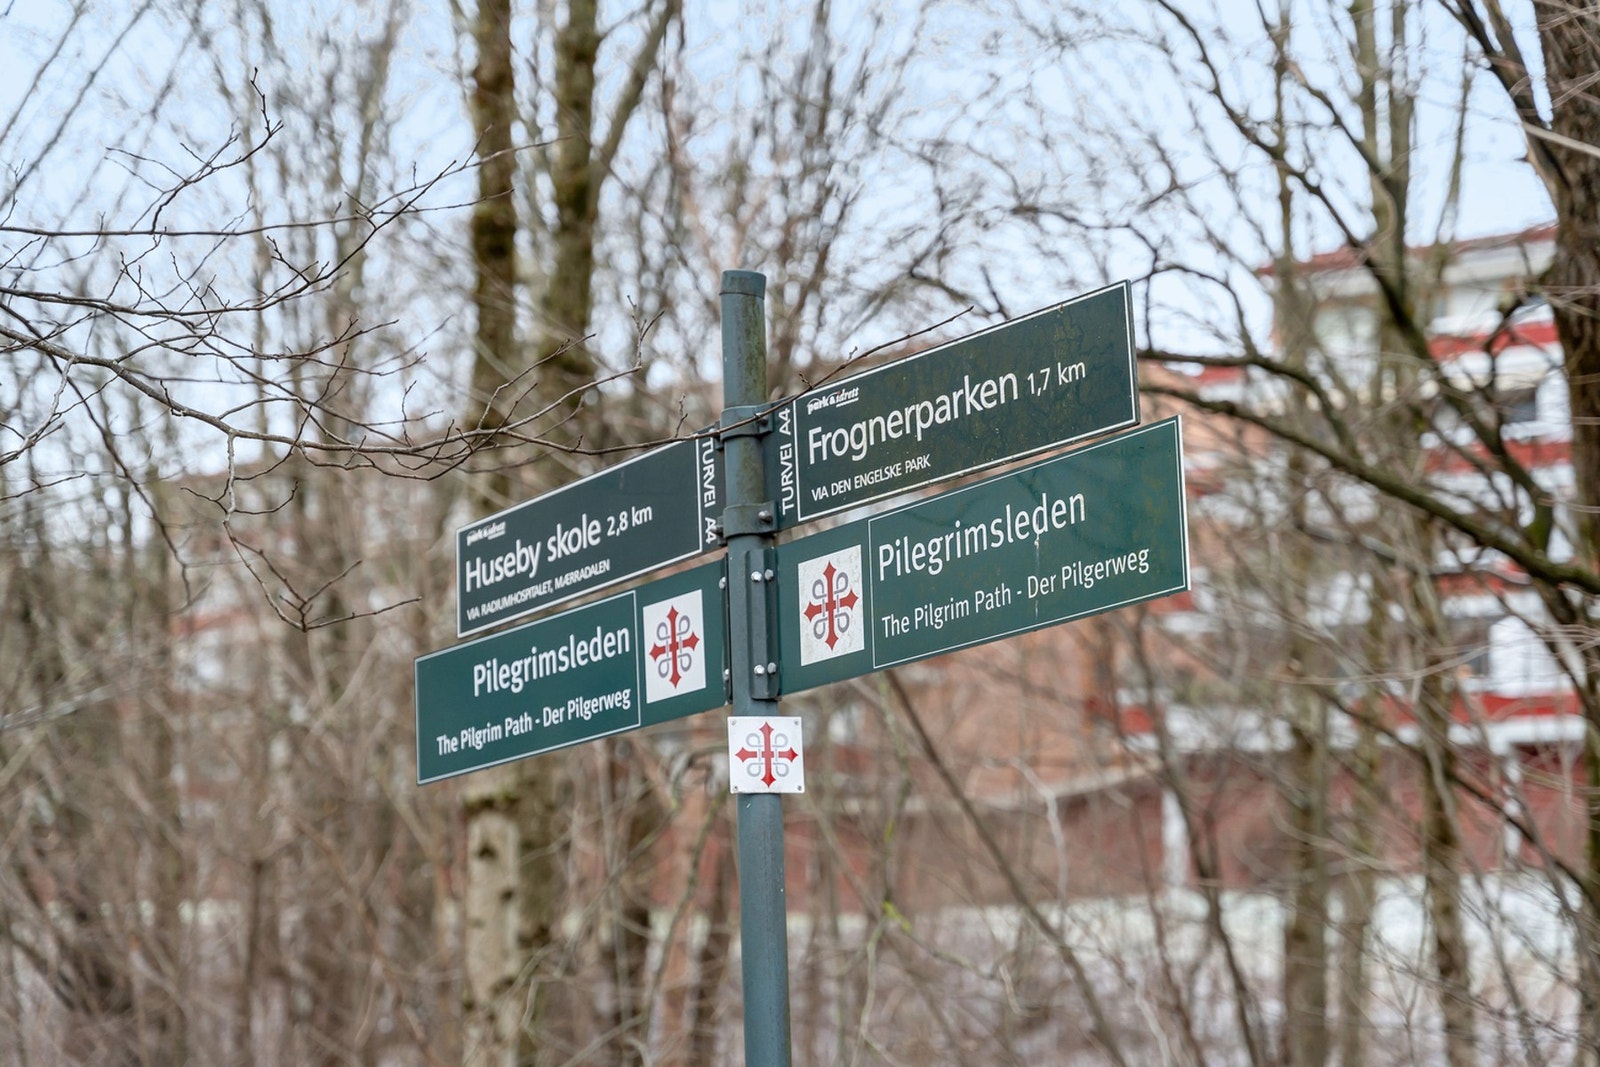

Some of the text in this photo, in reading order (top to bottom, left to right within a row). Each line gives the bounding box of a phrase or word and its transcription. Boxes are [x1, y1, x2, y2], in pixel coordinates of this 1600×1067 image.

[808, 359, 1086, 465] Frognerparken 1,7 km
[702, 437, 716, 508] TURVEI
[778, 407, 795, 516] TURVEI A4
[811, 453, 931, 502] VIA DEN ENGELSKE PARK
[465, 539, 542, 593] Huseby
[547, 513, 602, 563] skole
[606, 510, 629, 537] 2,8
[631, 505, 653, 527] km
[878, 492, 1086, 582] Pilegrimsleden
[466, 608, 481, 621] VIA
[882, 614, 910, 639] The
[914, 597, 970, 630] Pilgrim
[974, 583, 1012, 612] Path
[1026, 572, 1057, 600] Der
[1061, 547, 1150, 588] Pilgerweg
[473, 625, 630, 698] Pilegrimsleden
[436, 734, 458, 756] The
[460, 722, 503, 751] Pilgrim
[504, 712, 533, 738] Path
[542, 706, 565, 728] Der
[567, 687, 631, 721] Pilgerweg
